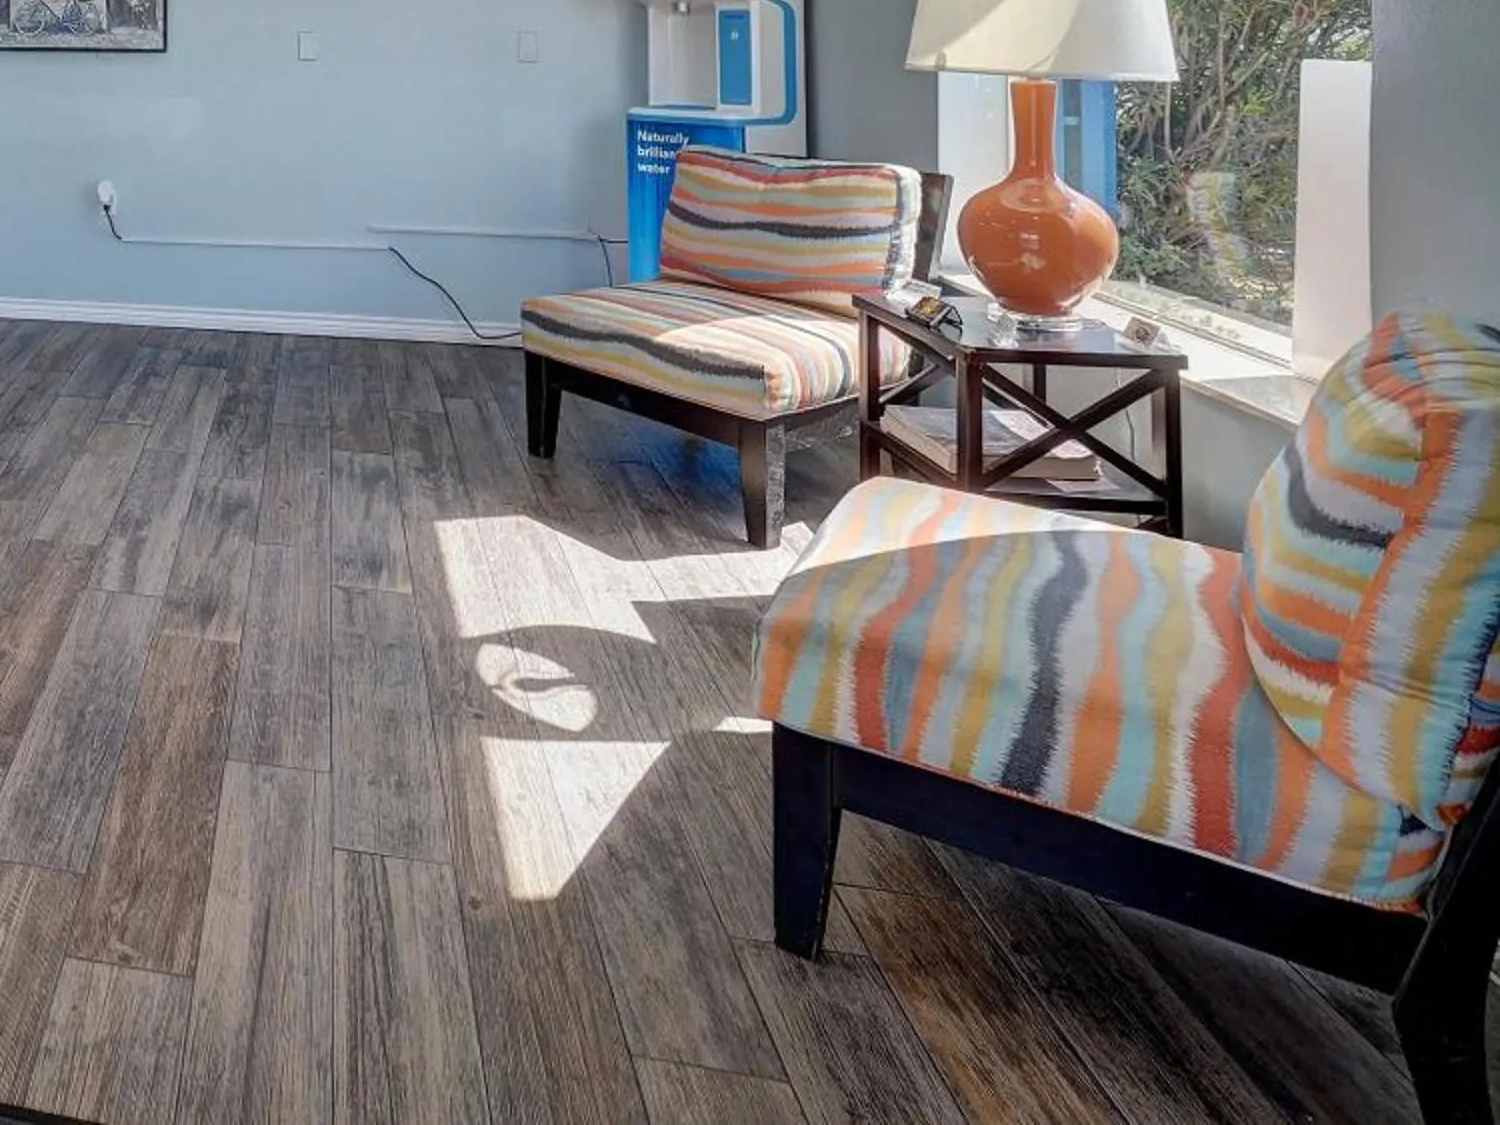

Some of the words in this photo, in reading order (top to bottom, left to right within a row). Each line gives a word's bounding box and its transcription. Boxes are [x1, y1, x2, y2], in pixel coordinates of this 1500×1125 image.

[637, 130, 690, 150] Naturally
[637, 144, 677, 160] brillian
[637, 162, 671, 174] water
